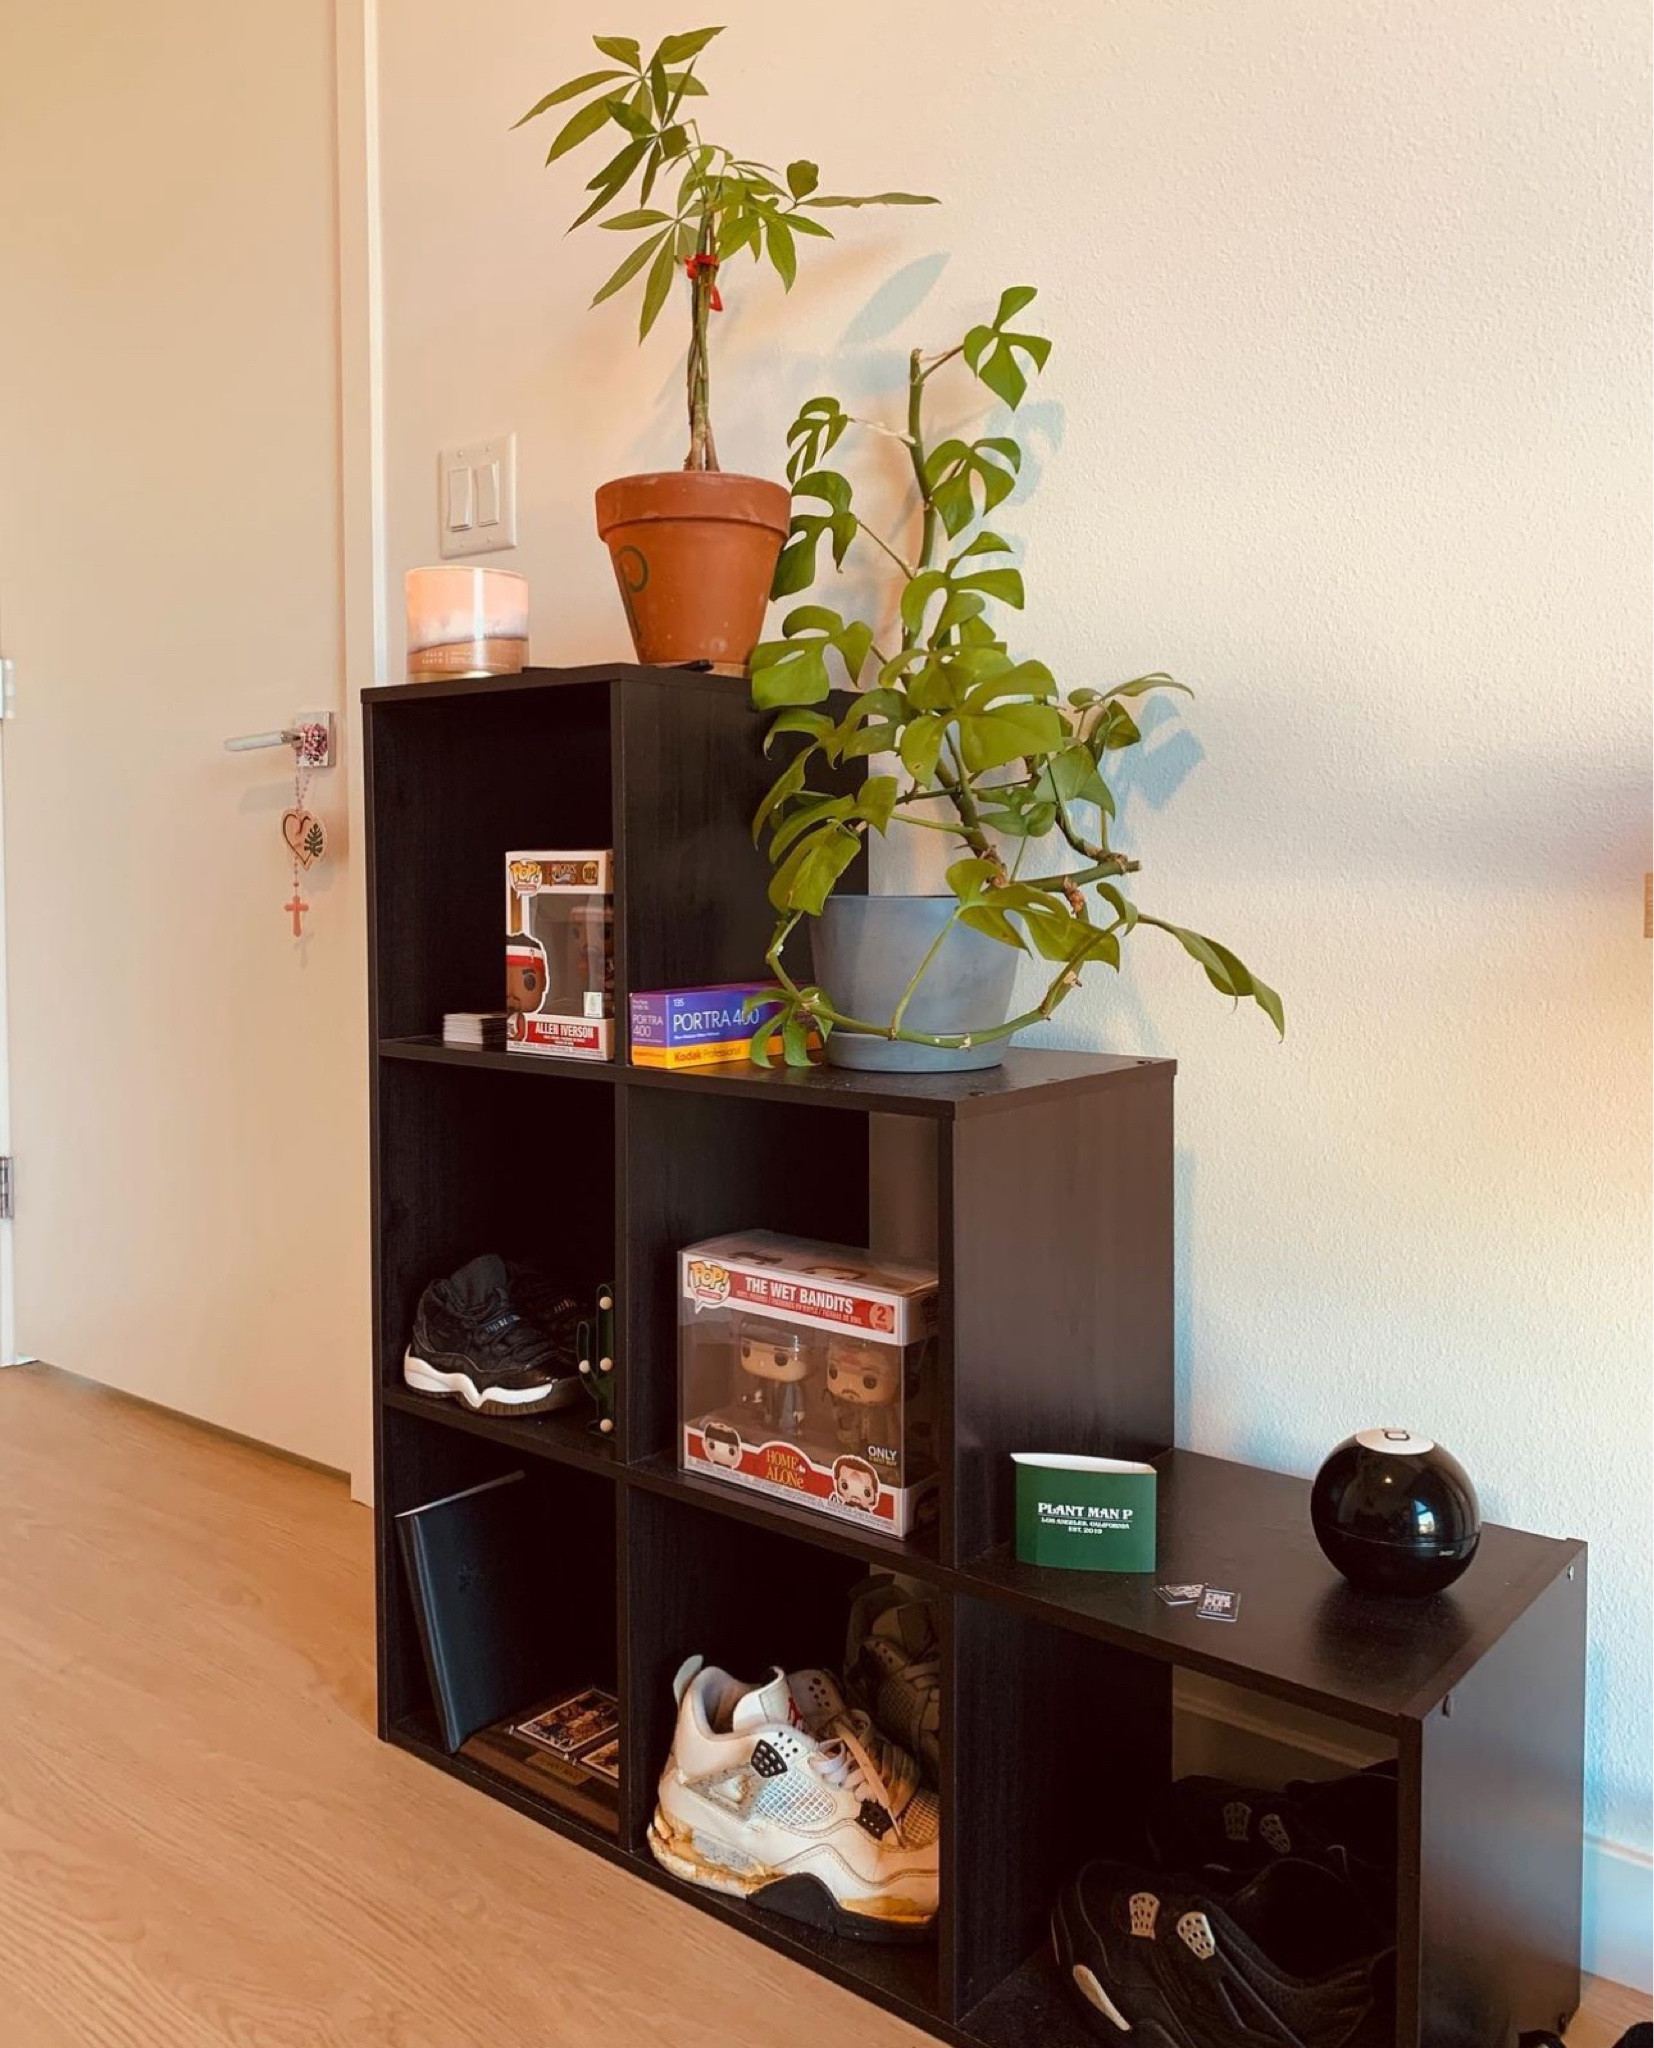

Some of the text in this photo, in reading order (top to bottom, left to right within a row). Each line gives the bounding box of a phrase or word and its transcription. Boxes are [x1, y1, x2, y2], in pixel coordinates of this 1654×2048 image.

[632, 1014, 664, 1026] PORTRA
[673, 1008, 760, 1033] PORTRA 400
[535, 1022, 594, 1039] ALLEN IVERSON
[633, 1025, 651, 1038] 400
[674, 1048, 702, 1062] Kodak
[690, 1260, 729, 1293] POP!
[745, 1276, 768, 1295] THE
[770, 1281, 797, 1302] WET
[799, 1286, 853, 1315] BANDITS
[876, 1305, 887, 1322] 2
[767, 1449, 798, 1470] HOME
[868, 1445, 897, 1461] ONLY
[1038, 1502, 1134, 1520] PLANT MAN P
